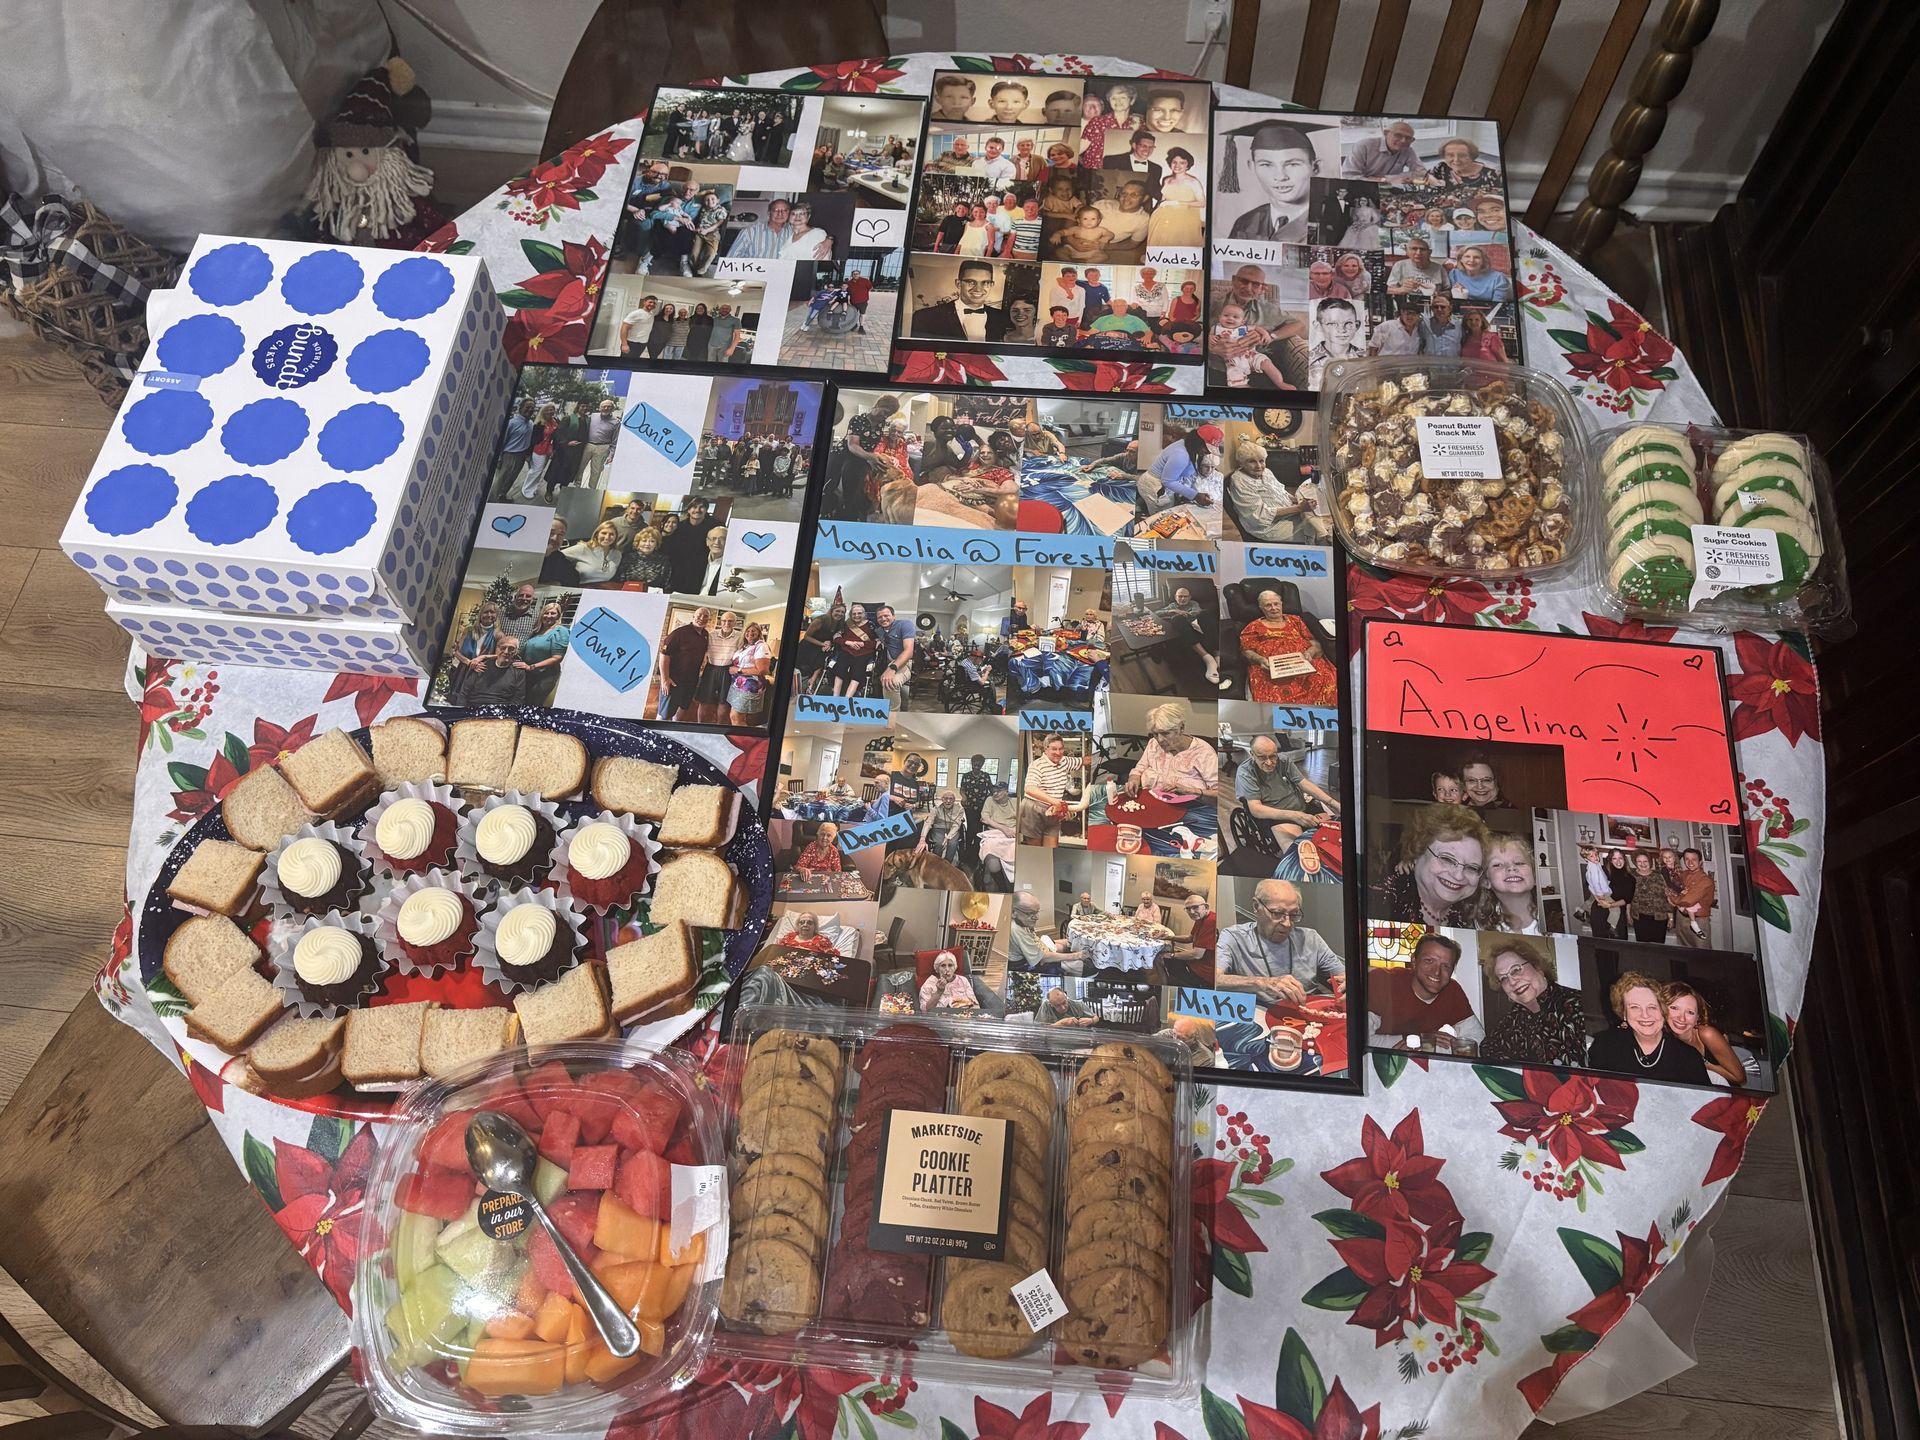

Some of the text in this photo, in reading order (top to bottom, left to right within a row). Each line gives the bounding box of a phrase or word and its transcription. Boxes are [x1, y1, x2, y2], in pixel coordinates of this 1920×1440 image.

[1213, 244, 1277, 261] Wendell
[718, 258, 766, 274] Mike
[266, 340, 284, 369] CAKES
[276, 324, 322, 390] bundt
[302, 342, 322, 373] NOTHING
[1168, 403, 1252, 420] Dorothy
[622, 402, 694, 463] Daniel
[816, 522, 1114, 568] Magnolia @ Forest
[1704, 536, 1729, 545] Sugar
[1717, 530, 1750, 539] Frosted
[1133, 551, 1216, 574] Wendell
[1250, 547, 1326, 575] Georgia
[1725, 552, 1770, 560] FRESHNESS
[1726, 558, 1770, 567] GUARANTEED
[576, 607, 644, 692] Family
[799, 694, 888, 722] Angelina
[1279, 706, 1338, 729] John
[1399, 679, 1588, 741] Angelina
[1021, 711, 1090, 730] Wade
[840, 814, 918, 850] Daniel
[1176, 989, 1254, 1021] Mike
[920, 1149, 970, 1173] COOKIE
[912, 1172, 973, 1197] PLATTER
[482, 1193, 525, 1214] PREPARE
[491, 1206, 524, 1224] in our
[495, 1219, 525, 1238] STORE
[906, 1234, 915, 1243] NET
[940, 1238, 945, 1246] (2
[946, 1239, 954, 1247] LB)
[955, 1239, 968, 1249] 907g
[1028, 1289, 1047, 1317] 12/23/25
